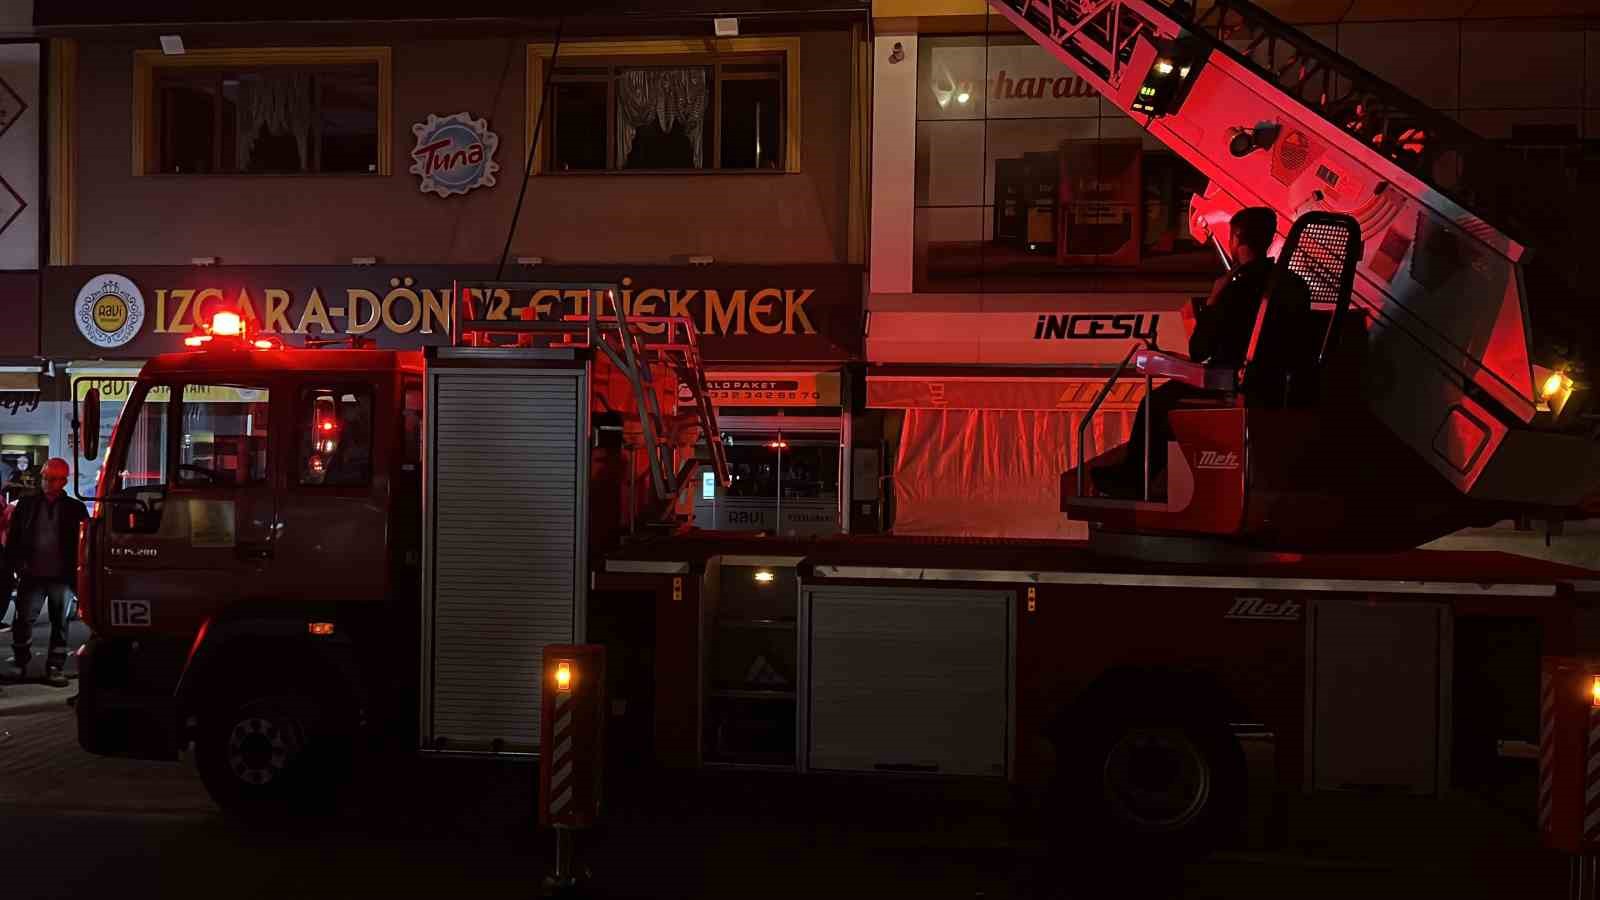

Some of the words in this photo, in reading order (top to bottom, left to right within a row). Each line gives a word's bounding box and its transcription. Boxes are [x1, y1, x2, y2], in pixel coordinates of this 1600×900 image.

[414, 139, 483, 175] Tuna
[733, 380, 776, 389] PAKET
[113, 602, 149, 624] 112
